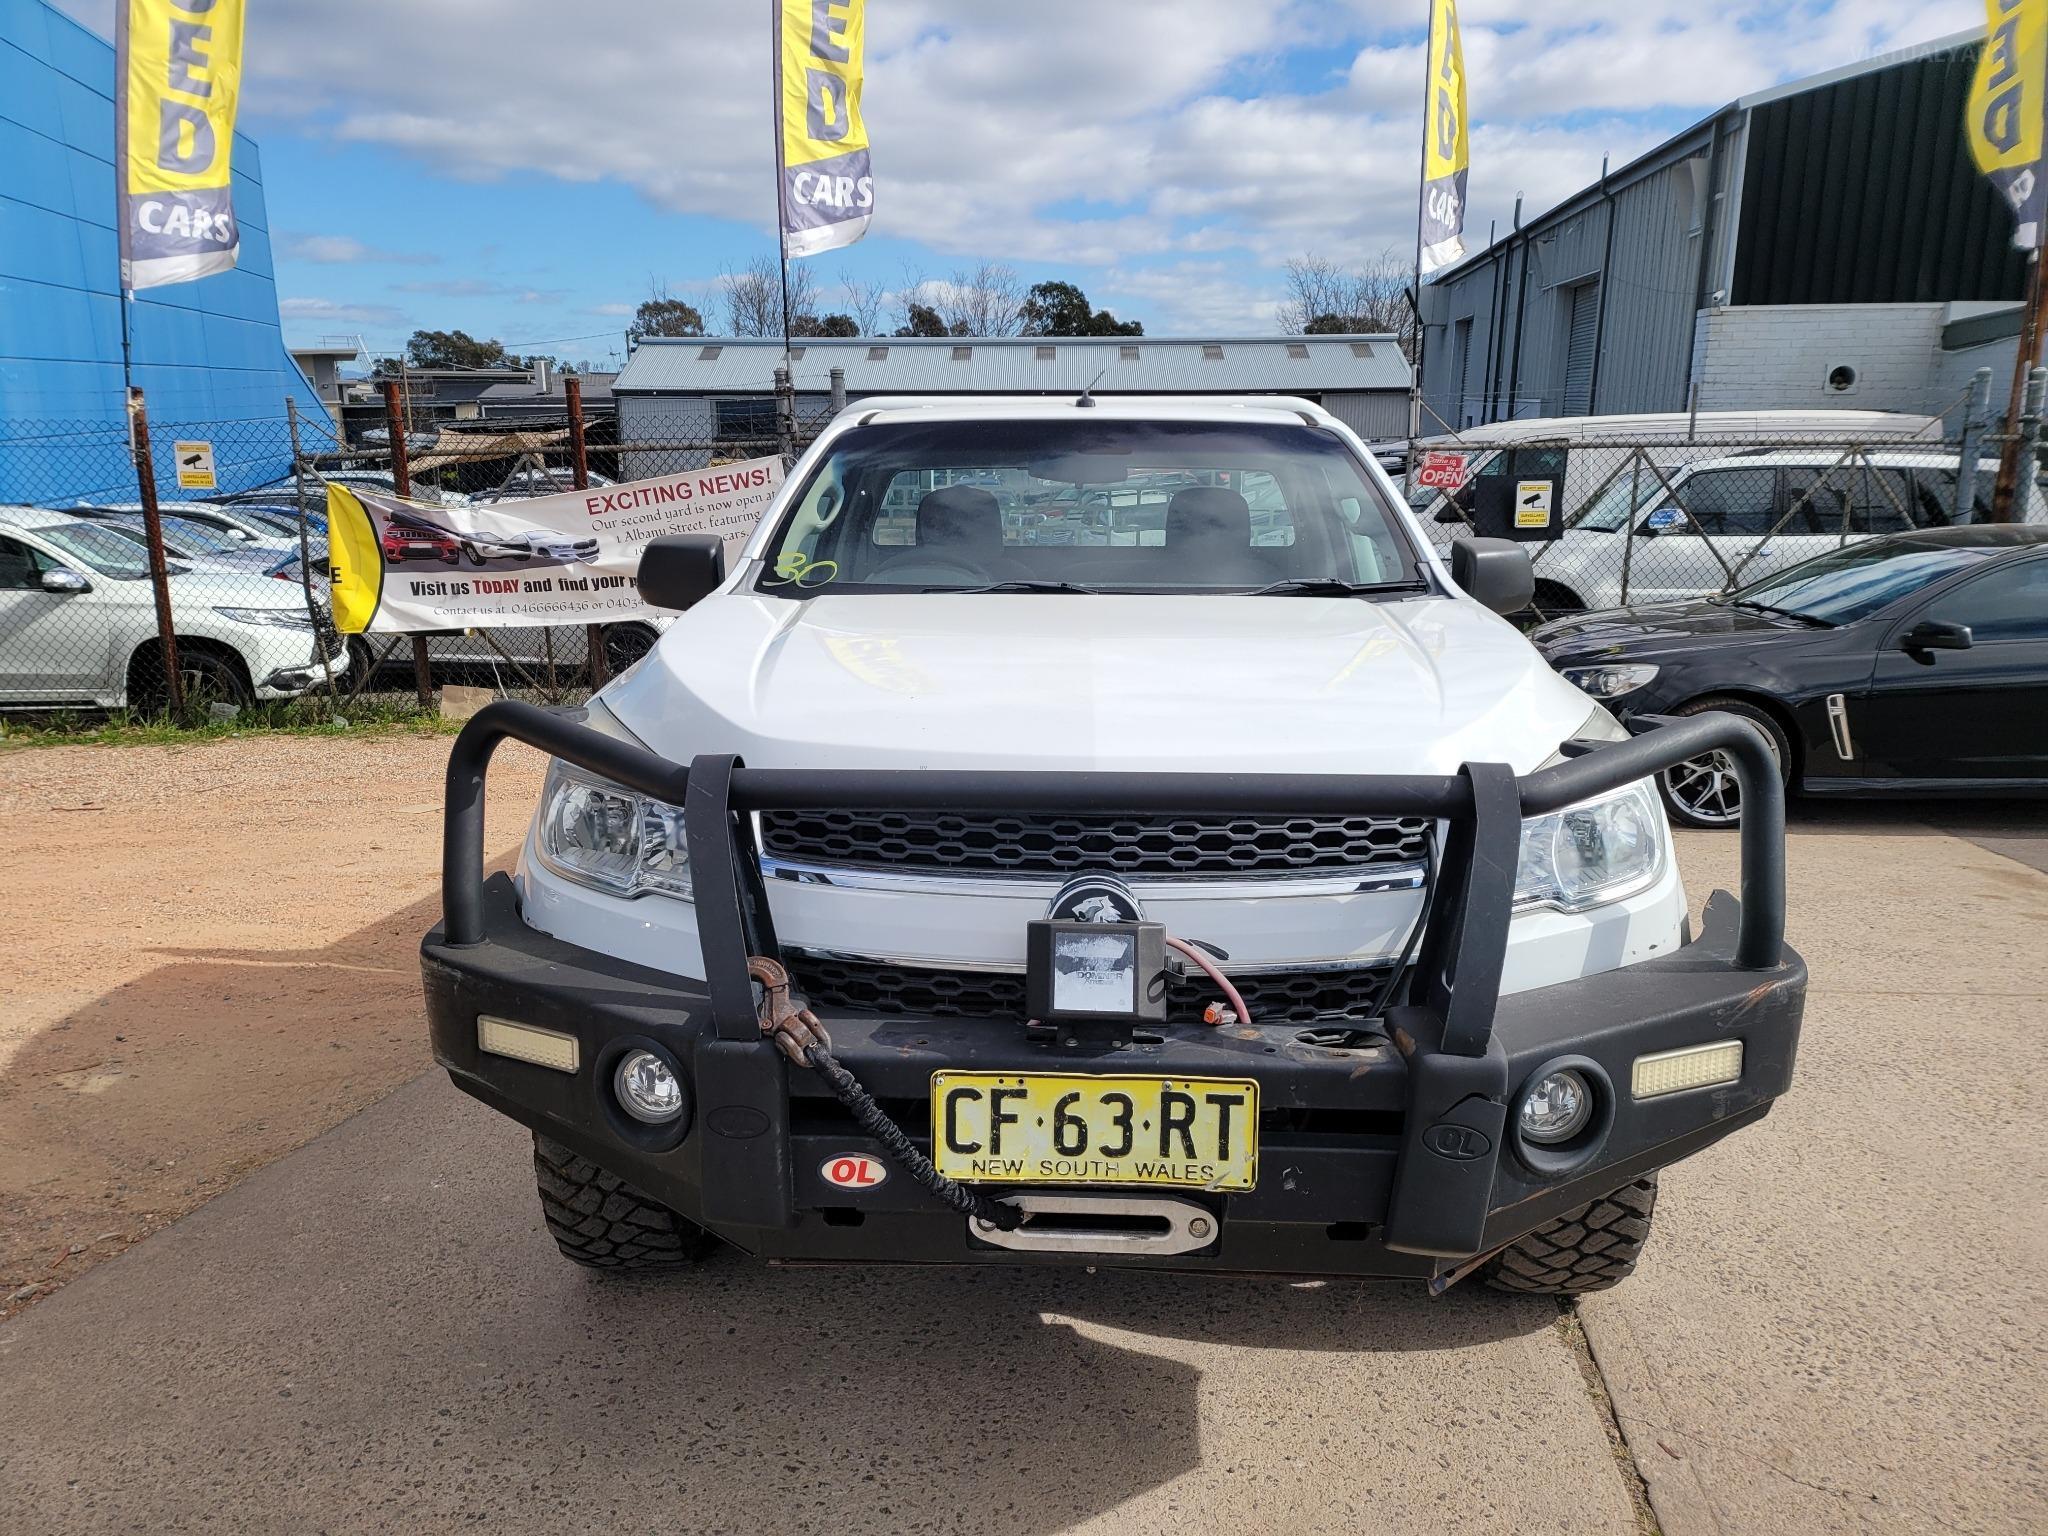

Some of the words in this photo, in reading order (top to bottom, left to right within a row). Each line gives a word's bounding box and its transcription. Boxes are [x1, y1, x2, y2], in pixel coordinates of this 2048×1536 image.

[794, 172, 873, 207] CARS
[138, 200, 230, 243] CARS
[1422, 470, 1464, 485] OPEN
[585, 481, 693, 516] EXCITING
[699, 467, 772, 497] NEWS!
[591, 519, 618, 531] Our
[621, 508, 661, 526] second
[664, 503, 692, 522] yard
[694, 501, 705, 514] is
[707, 500, 732, 512] now
[736, 493, 763, 509] open
[766, 490, 775, 501] at
[669, 520, 707, 535] Street,
[709, 510, 761, 527] featuring
[722, 530, 750, 542] cars.
[409, 581, 448, 596] Visit
[450, 582, 470, 595] us
[472, 579, 519, 594] TODAY
[523, 578, 553, 593] and
[558, 576, 588, 591] find
[591, 575, 625, 591] your
[433, 606, 477, 616] Contact
[480, 606, 493, 615] us
[495, 605, 505, 614] at
[592, 601, 604, 610] or
[831, 1159, 875, 1184] OL
[972, 1158, 1024, 1177] NEW
[1039, 1158, 1120, 1178] SOUTH
[1134, 1160, 1215, 1182] WALES
